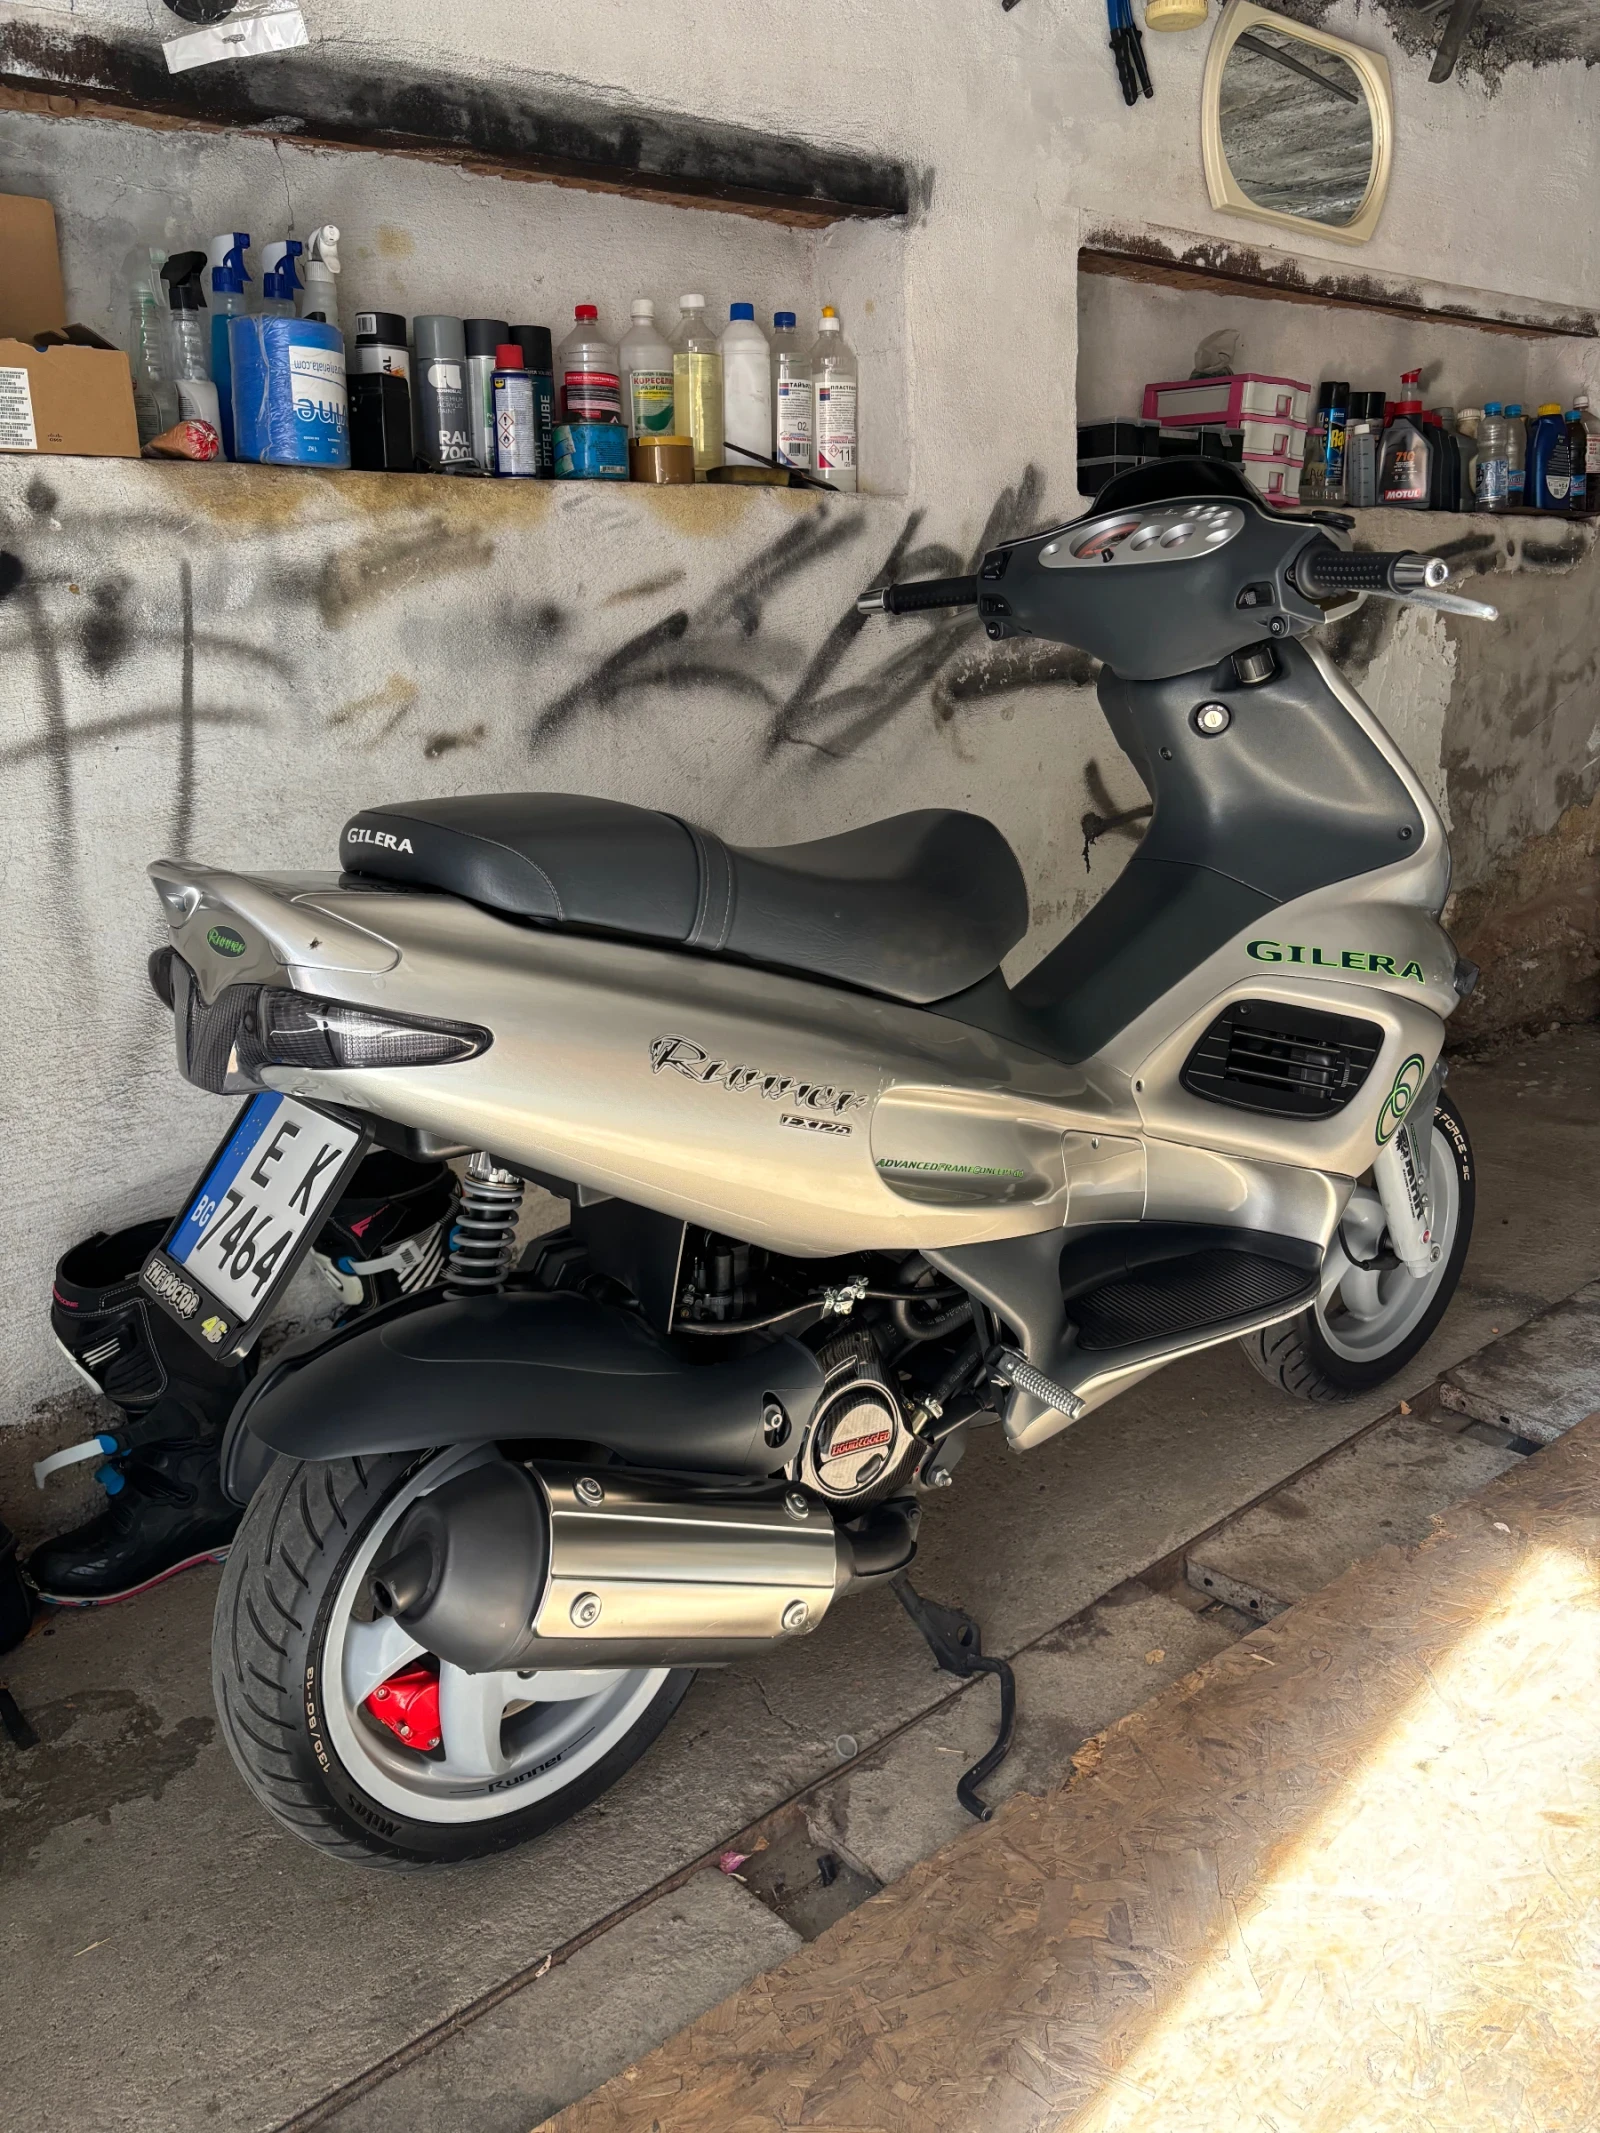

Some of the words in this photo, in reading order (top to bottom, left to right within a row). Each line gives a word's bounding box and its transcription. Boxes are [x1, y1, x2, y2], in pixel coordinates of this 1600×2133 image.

[541, 395, 551, 430] LUBE
[439, 431, 470, 445] RAL
[440, 446, 471, 460] 7001
[542, 434, 552, 467] PTFE
[1396, 451, 1415, 461] 710
[1386, 489, 1419, 500] MOTUL
[347, 828, 414, 854] GILERA
[1246, 940, 1426, 985] GILERA
[649, 1034, 870, 1116] Runner
[190, 1195, 216, 1228] BG
[196, 1188, 295, 1299] 7464
[144, 1259, 170, 1287] THE
[157, 1272, 200, 1319] DOCTOR
[201, 1315, 228, 1343] 46
[487, 1749, 569, 1793] Runner
